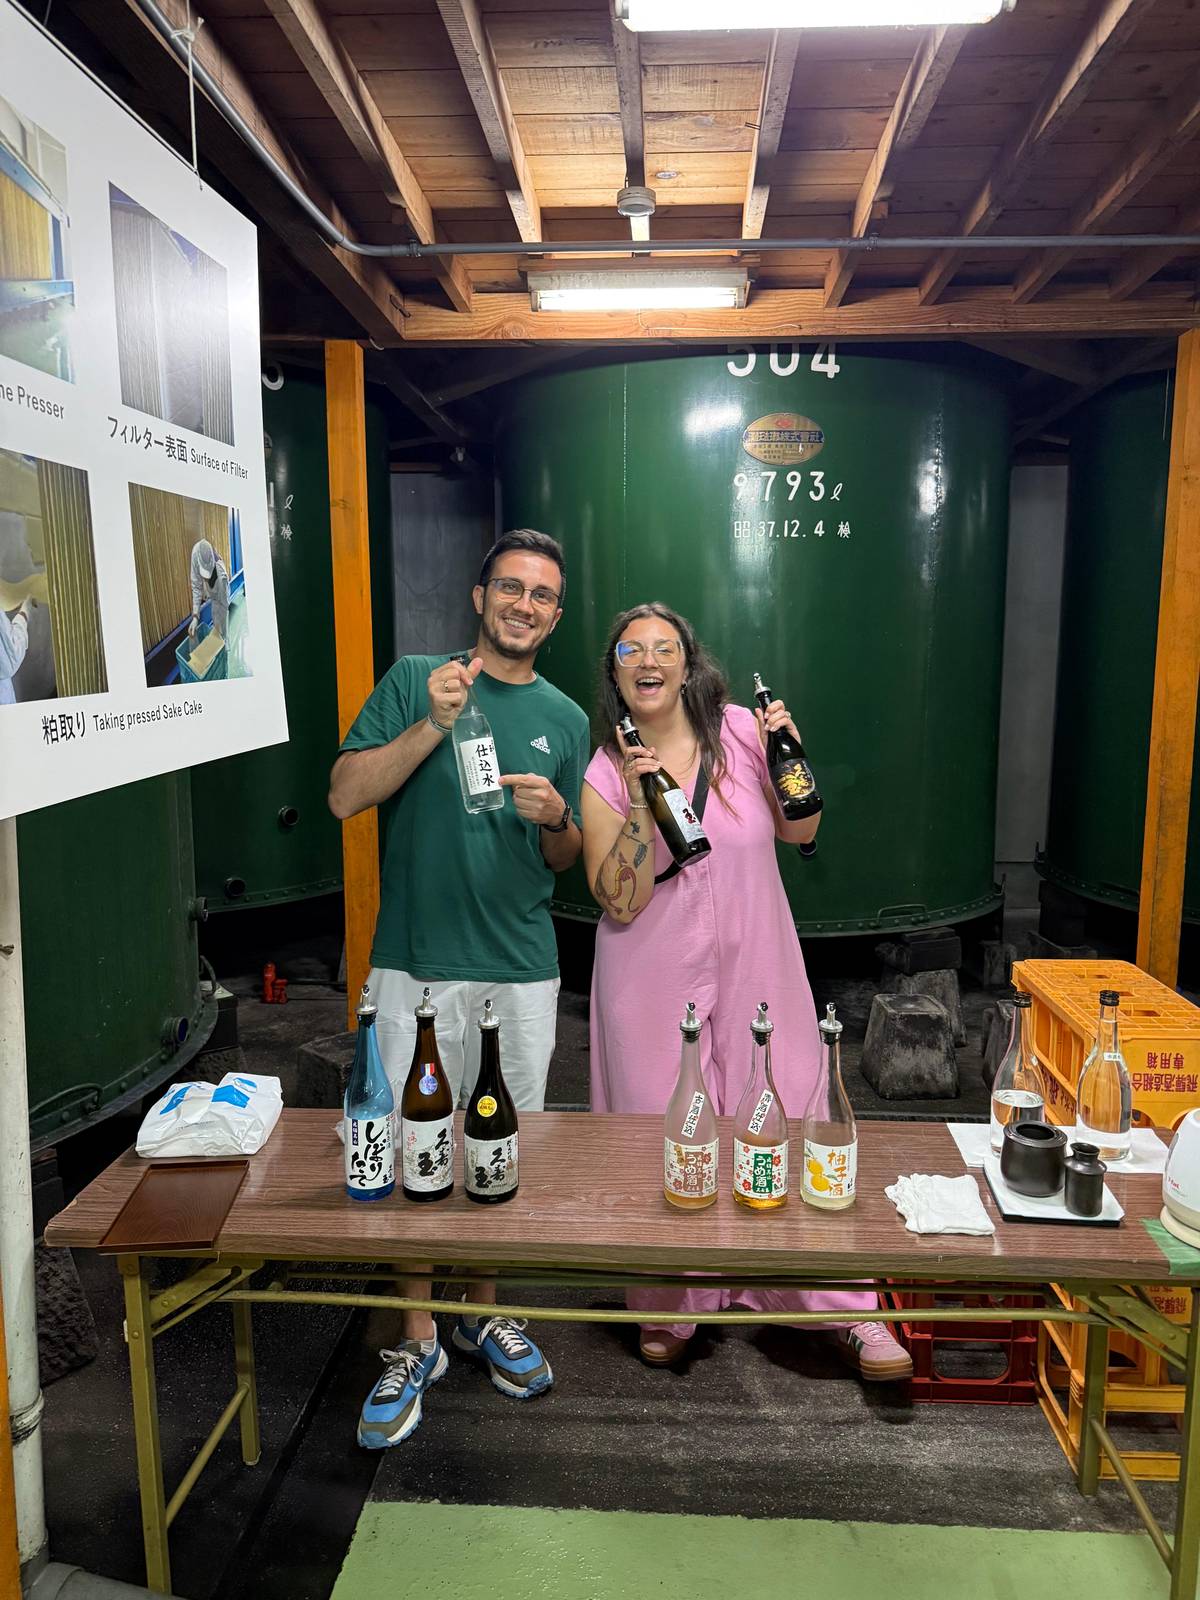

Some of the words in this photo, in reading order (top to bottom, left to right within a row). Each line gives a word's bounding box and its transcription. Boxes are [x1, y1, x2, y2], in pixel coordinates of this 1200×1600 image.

[17, 385, 65, 419] Presser
[107, 416, 188, 464] フィルター表面
[190, 448, 220, 471] Surface
[221, 460, 229, 474] of
[230, 461, 249, 480] Filter
[733, 520, 751, 539] 昭
[41, 711, 87, 745] 粕取り
[92, 712, 126, 732] Taking
[126, 705, 161, 730] pressed
[162, 703, 183, 720] Sake
[183, 700, 203, 716] Cake
[474, 743, 496, 787] 仕込水
[685, 1155, 698, 1186] うめ酒
[754, 1155, 767, 1187] うめ酒
[827, 1149, 847, 1196] 柚子酒
